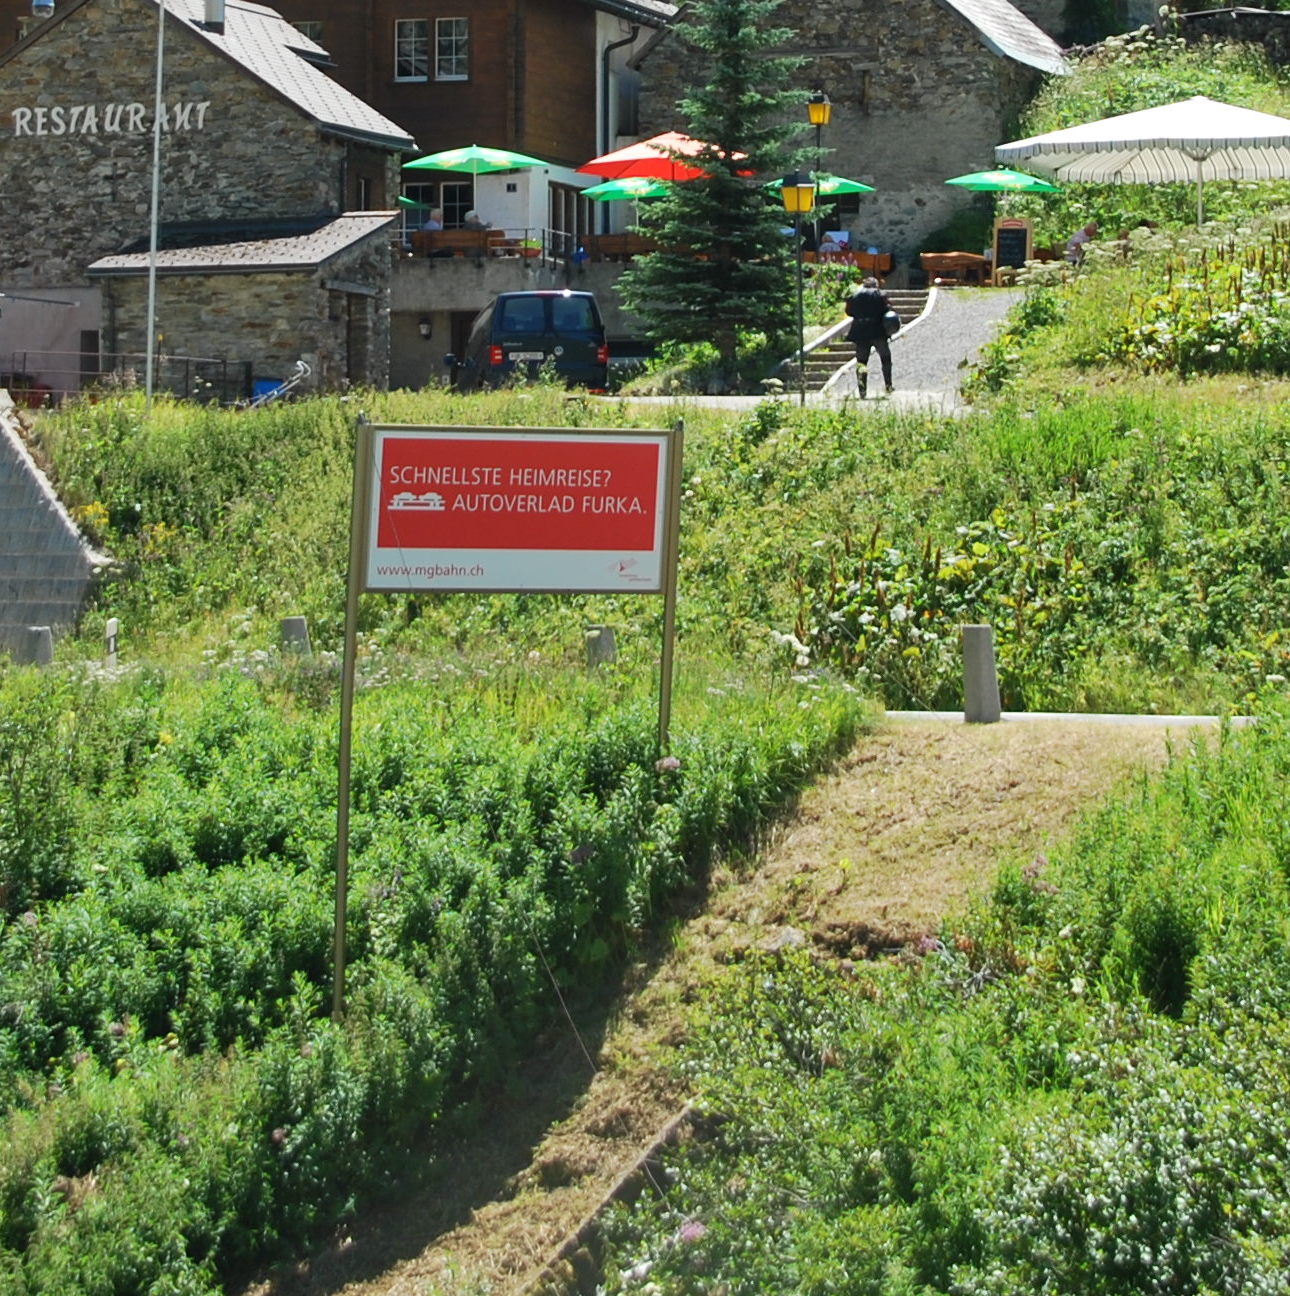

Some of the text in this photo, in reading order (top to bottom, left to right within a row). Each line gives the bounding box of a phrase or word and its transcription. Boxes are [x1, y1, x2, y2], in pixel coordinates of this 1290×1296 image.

[12, 101, 211, 136] RESTAURANT
[390, 466, 612, 487] SCHNELLSTE HEIMREISE?
[452, 494, 647, 514] AUTOVERLAD FURKA.
[377, 563, 484, 579] www.mgbahn.ch
